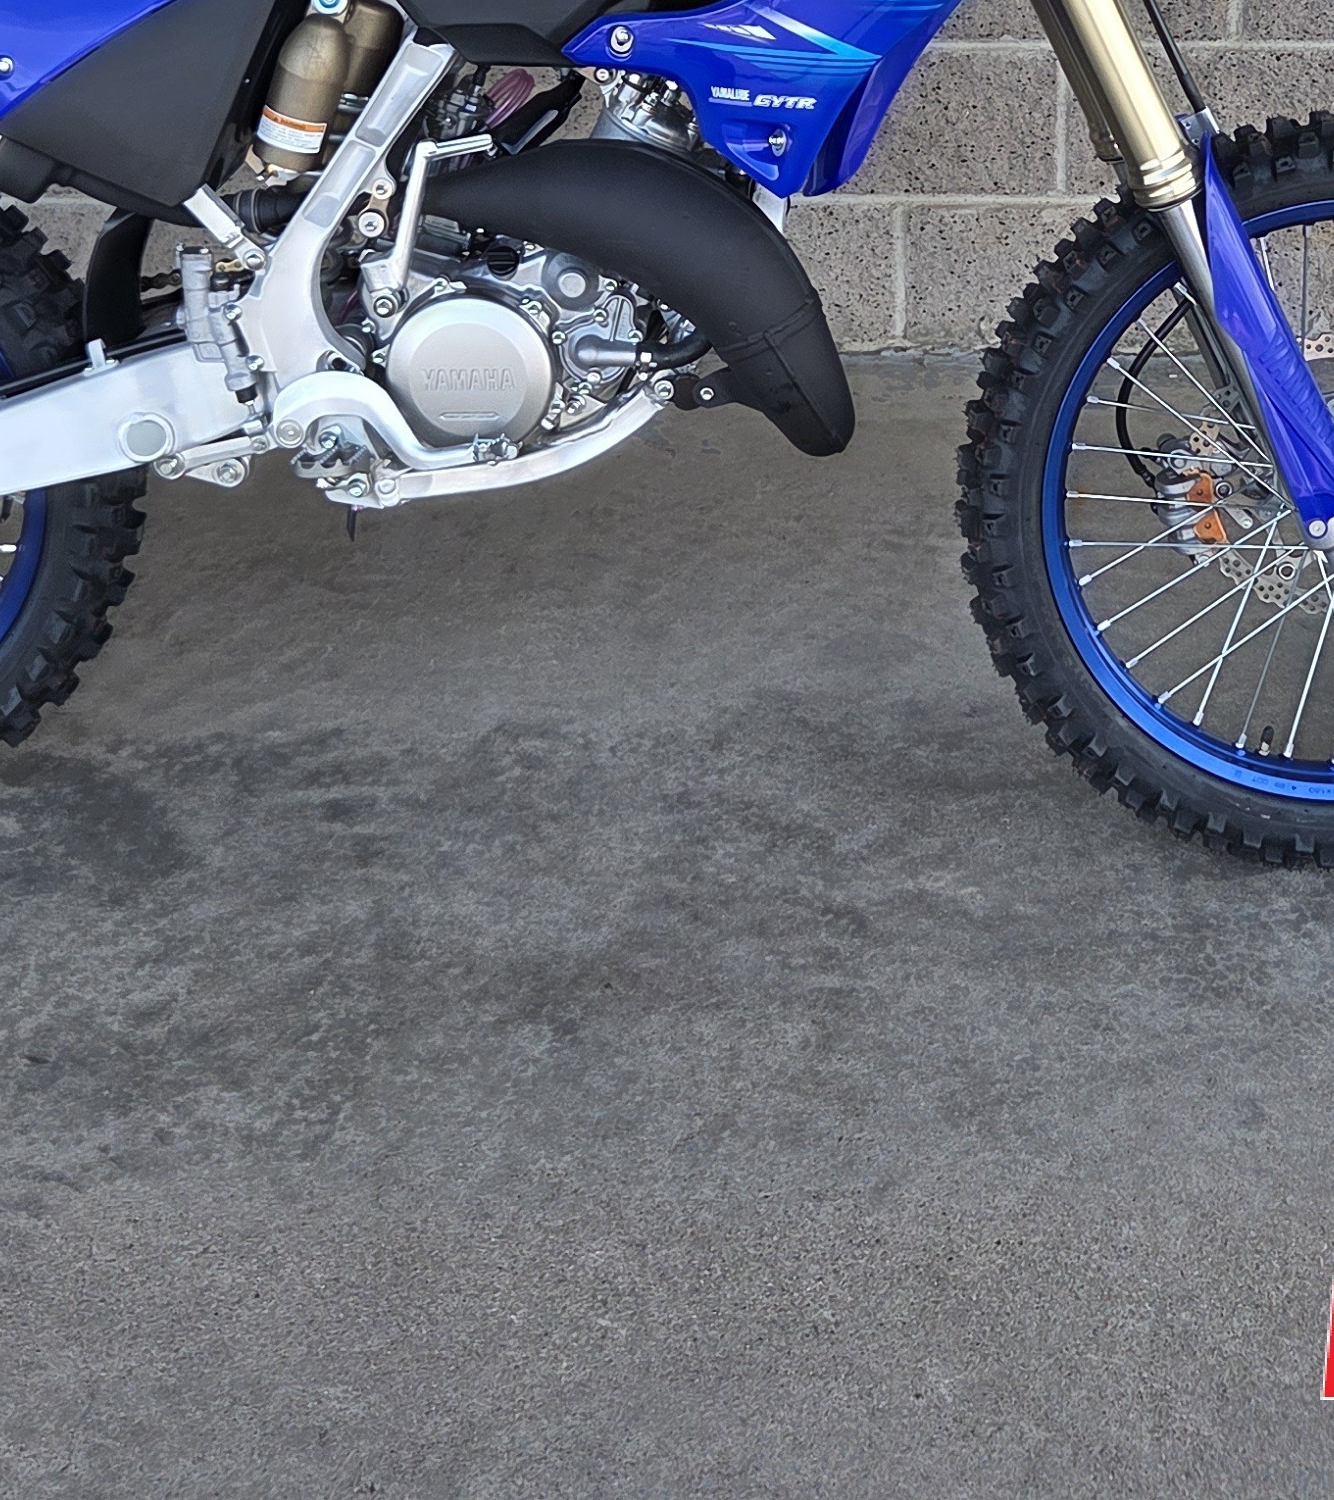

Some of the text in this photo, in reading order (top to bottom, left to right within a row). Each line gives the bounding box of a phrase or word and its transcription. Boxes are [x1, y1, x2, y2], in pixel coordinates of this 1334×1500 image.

[711, 86, 817, 109] YAMALUBE GYTR
[421, 367, 515, 390] YAMAHA
